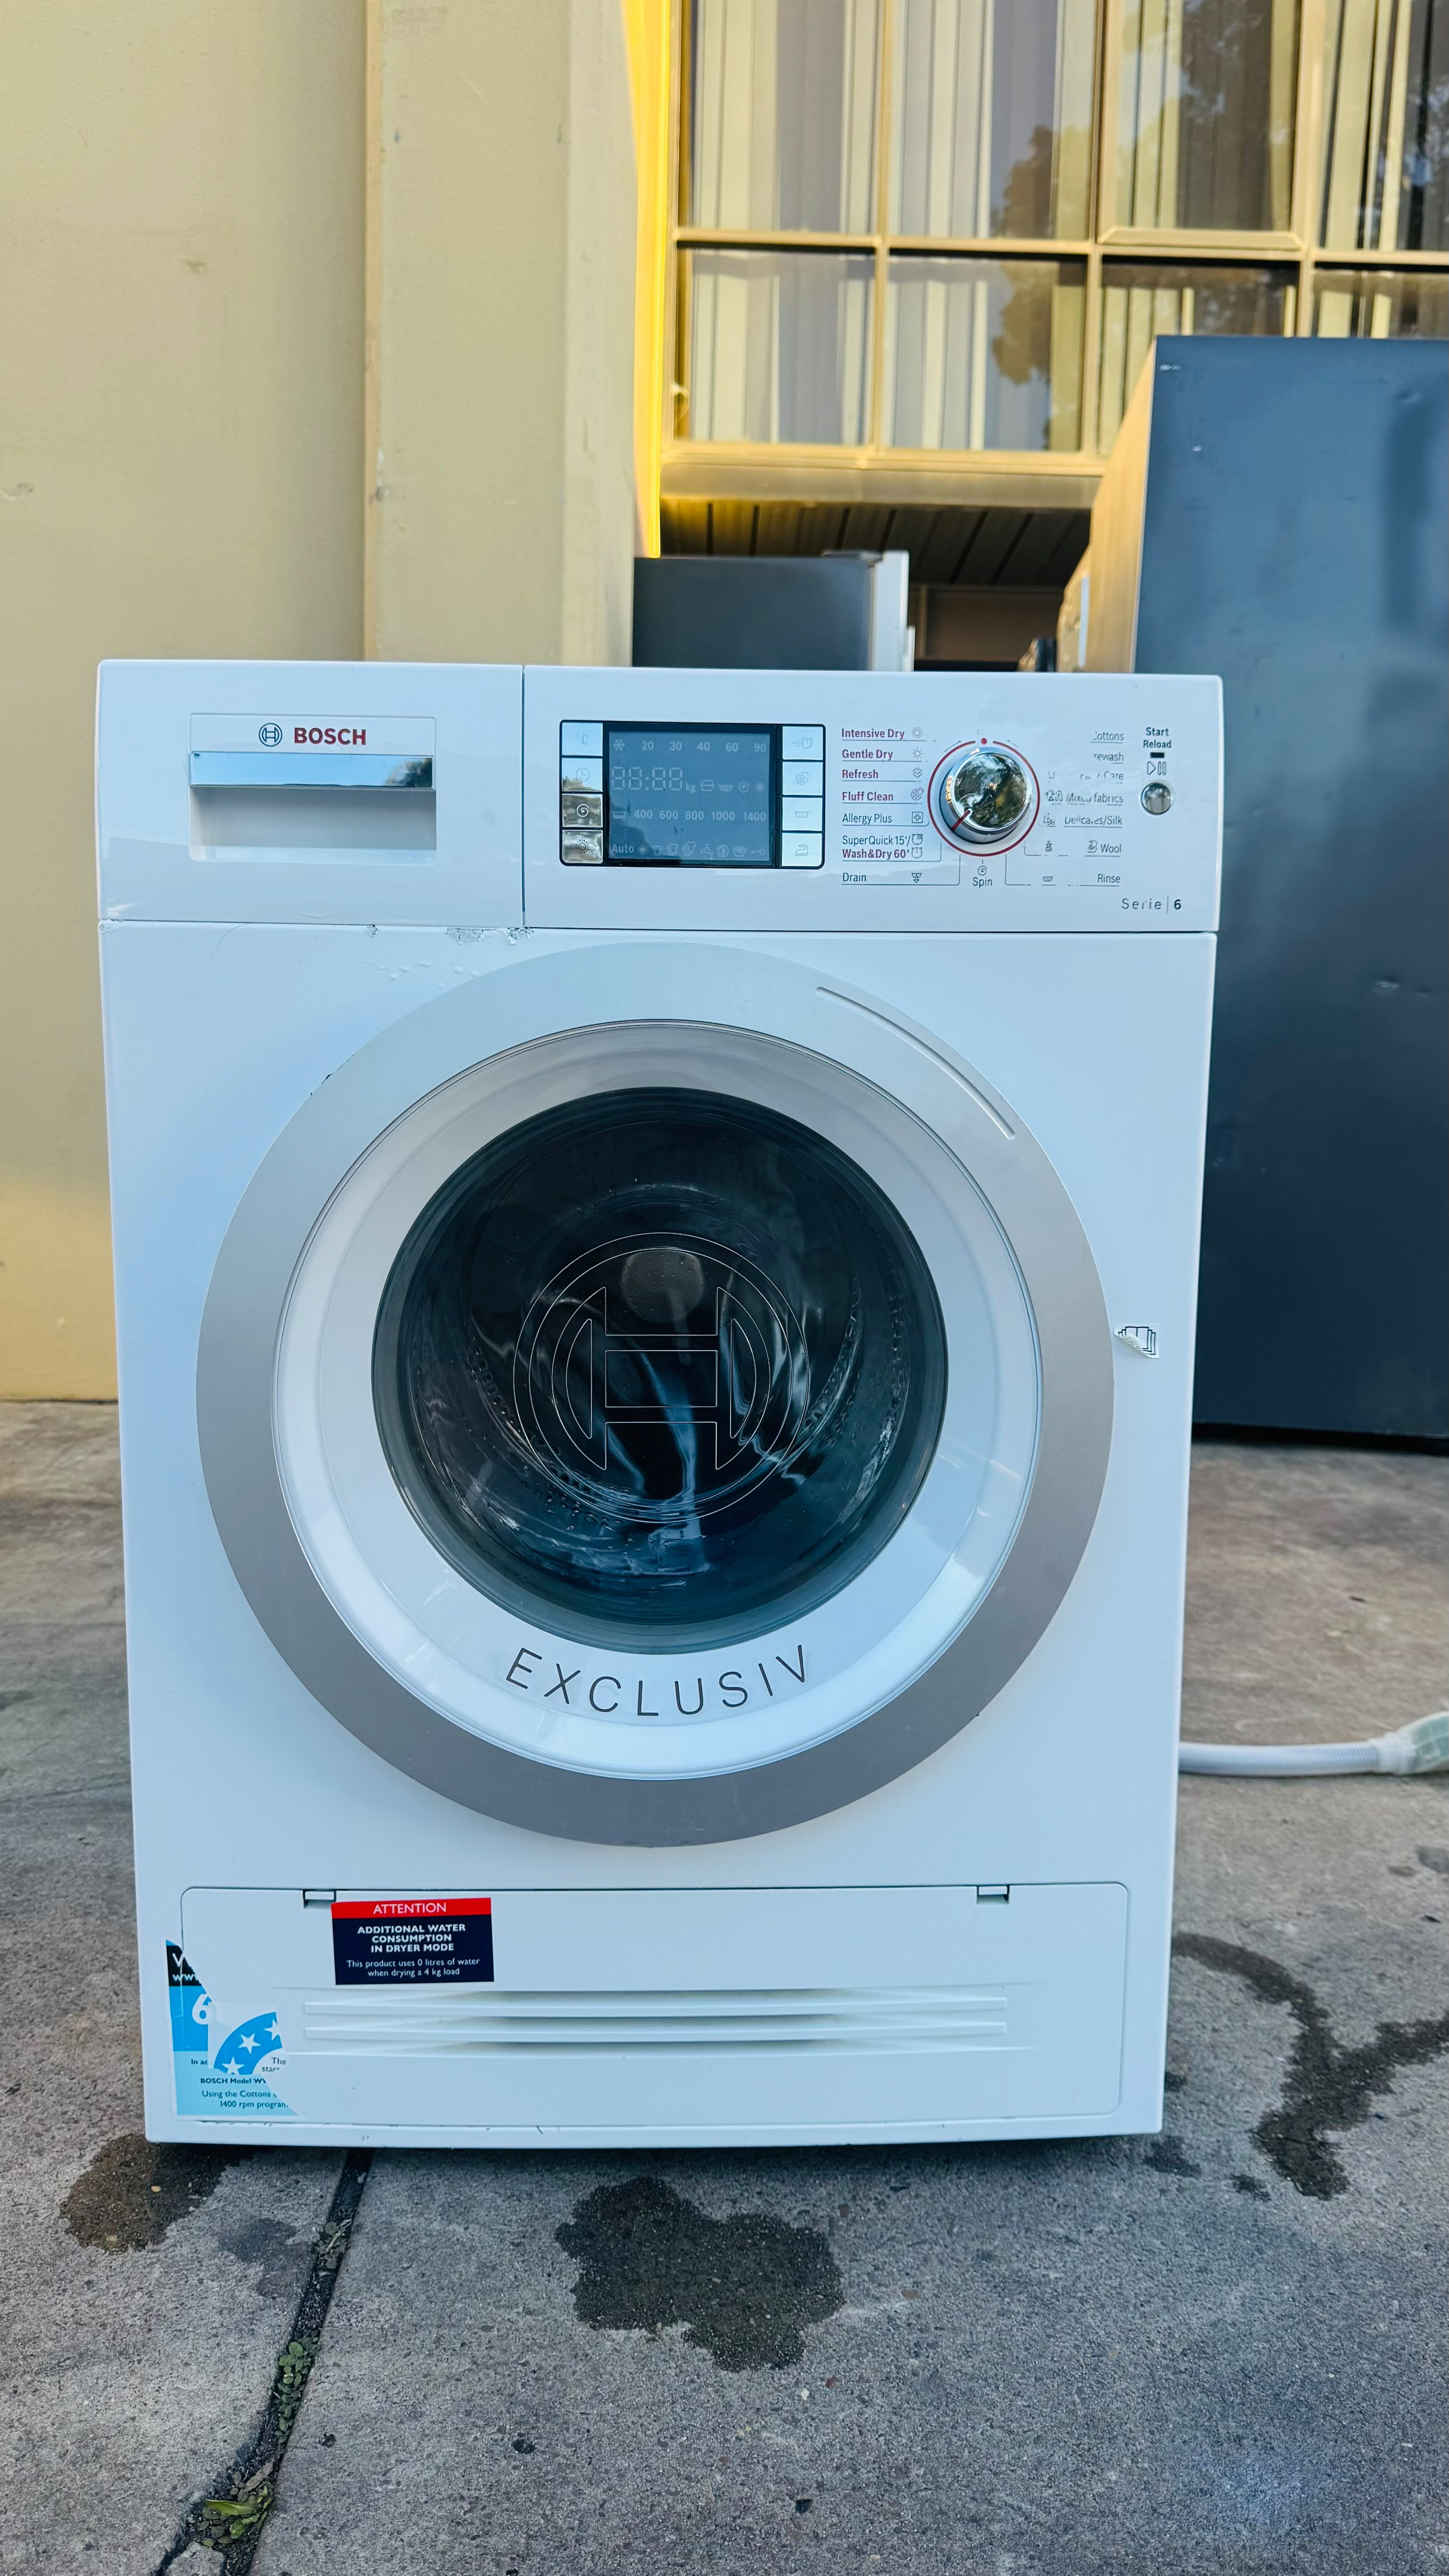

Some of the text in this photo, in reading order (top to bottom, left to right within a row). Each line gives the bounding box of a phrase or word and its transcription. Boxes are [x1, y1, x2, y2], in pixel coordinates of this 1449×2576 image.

[294, 728, 366, 746] BOSCH
[842, 729, 905, 740] Intensive Dry
[1146, 728, 1169, 737] Start
[641, 741, 767, 753] 20 30 40 60 90
[1143, 740, 1171, 749] Reload
[842, 750, 893, 761] Gentle Dry
[842, 769, 878, 779] Refresh
[686, 783, 696, 793] kg
[842, 791, 894, 801] Fluff Clean
[1094, 793, 1123, 802] fabrics
[634, 810, 766, 822] 400 600 800 1000 1400
[842, 813, 892, 825] Allergy Plus
[612, 844, 634, 854] Auto
[1101, 844, 1121, 853] Wool
[842, 849, 892, 860] Wash&Dry
[843, 872, 866, 882] Drain
[1097, 874, 1120, 883] Rinse
[973, 877, 993, 888] Spin
[1122, 899, 1181, 910] Serie 6
[506, 1644, 805, 1716] EXCLUSIV
[373, 1903, 446, 1914] ATTENTION
[357, 1924, 466, 1934] ADDITIONAL WATER
[372, 1934, 452, 1943] CONSUMPTION
[386, 1944, 420, 1952] DRYER
[365, 1959, 396, 1968] product
[391, 1969, 415, 1978] drying
[432, 1968, 441, 1977] kg
[202, 2090, 223, 2099] Using
